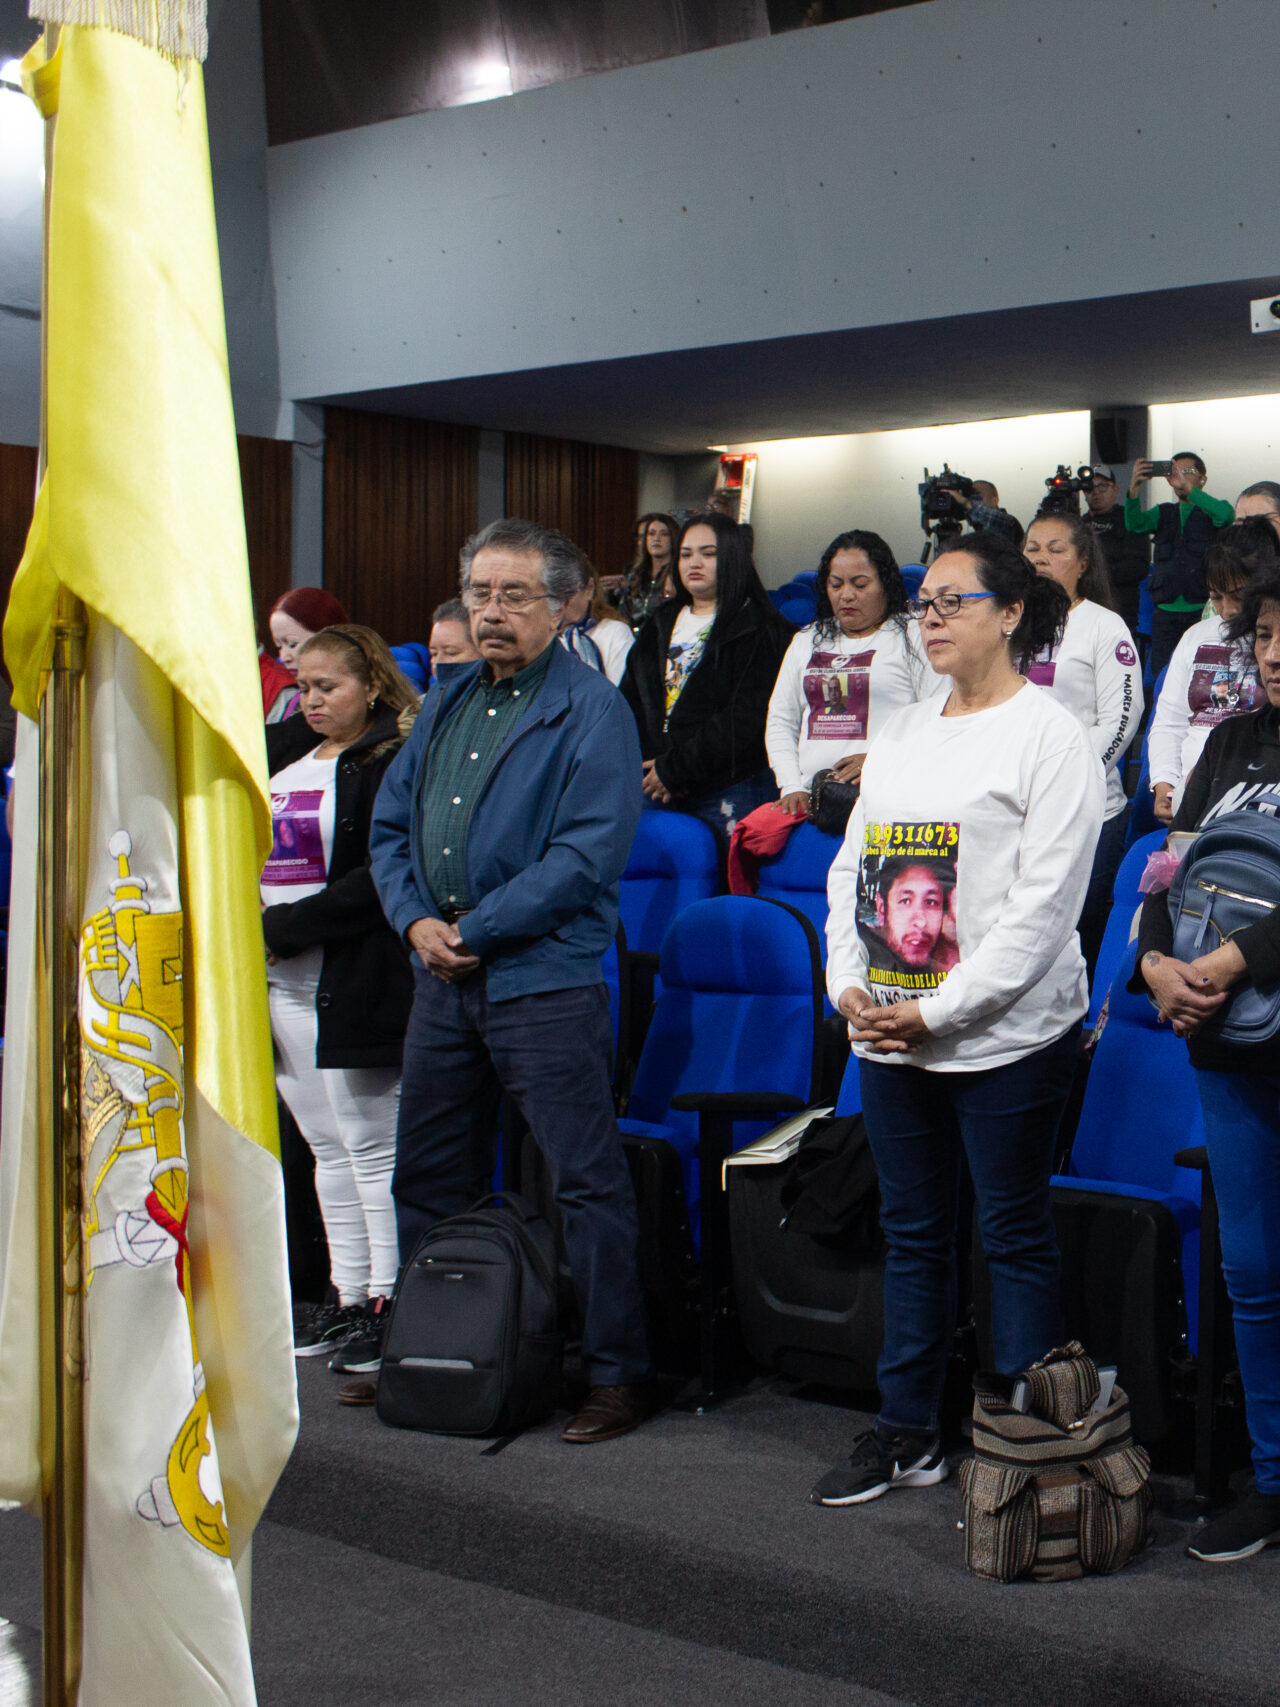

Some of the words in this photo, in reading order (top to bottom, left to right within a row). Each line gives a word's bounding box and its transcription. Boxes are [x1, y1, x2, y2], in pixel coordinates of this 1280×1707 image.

[1123, 674, 1133, 712] MADRES
[897, 846, 906, 856] de
[940, 846, 948, 856] al
[914, 974, 925, 988] DE
[925, 972, 937, 988] LA
